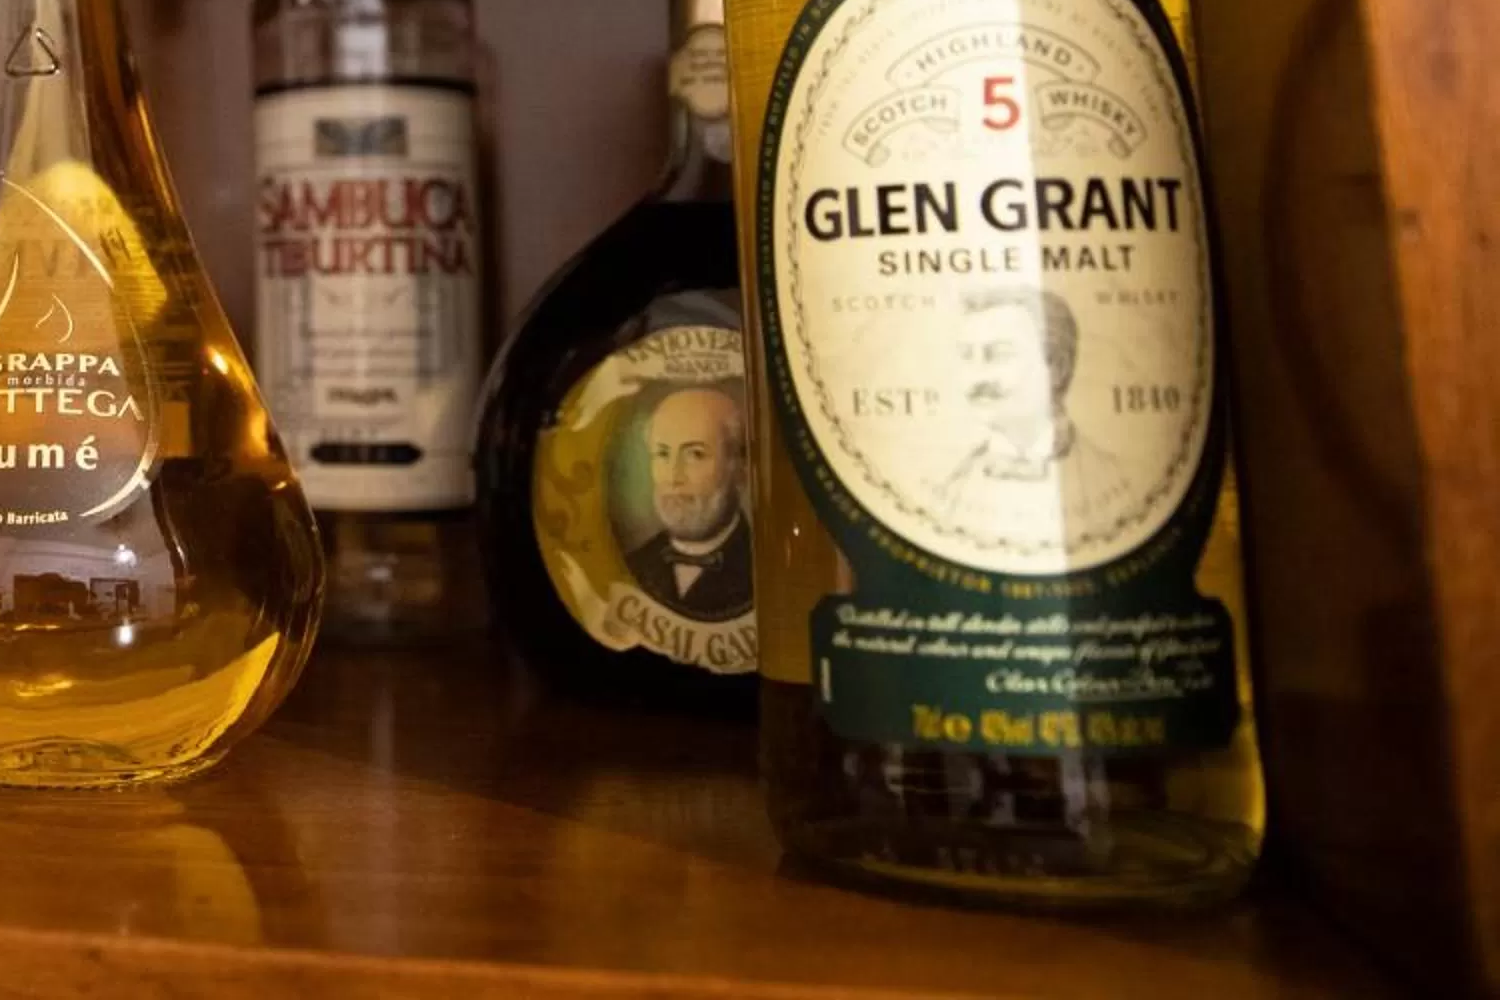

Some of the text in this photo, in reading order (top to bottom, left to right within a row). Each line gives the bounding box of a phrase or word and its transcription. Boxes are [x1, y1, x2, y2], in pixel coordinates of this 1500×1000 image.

[915, 31, 1072, 72] HIGHLAND
[852, 94, 948, 147] SCOTCH
[982, 76, 1021, 131] 5
[1049, 88, 1139, 137] WHISKY
[260, 176, 476, 233] SAMBUCA
[803, 181, 959, 243] GLEN
[979, 175, 1183, 234] GRANT
[878, 244, 1136, 278] SINGLE MALT
[7, 374, 87, 389] morbida
[7, 510, 69, 526] Barricata
[616, 594, 699, 665] CASAL
